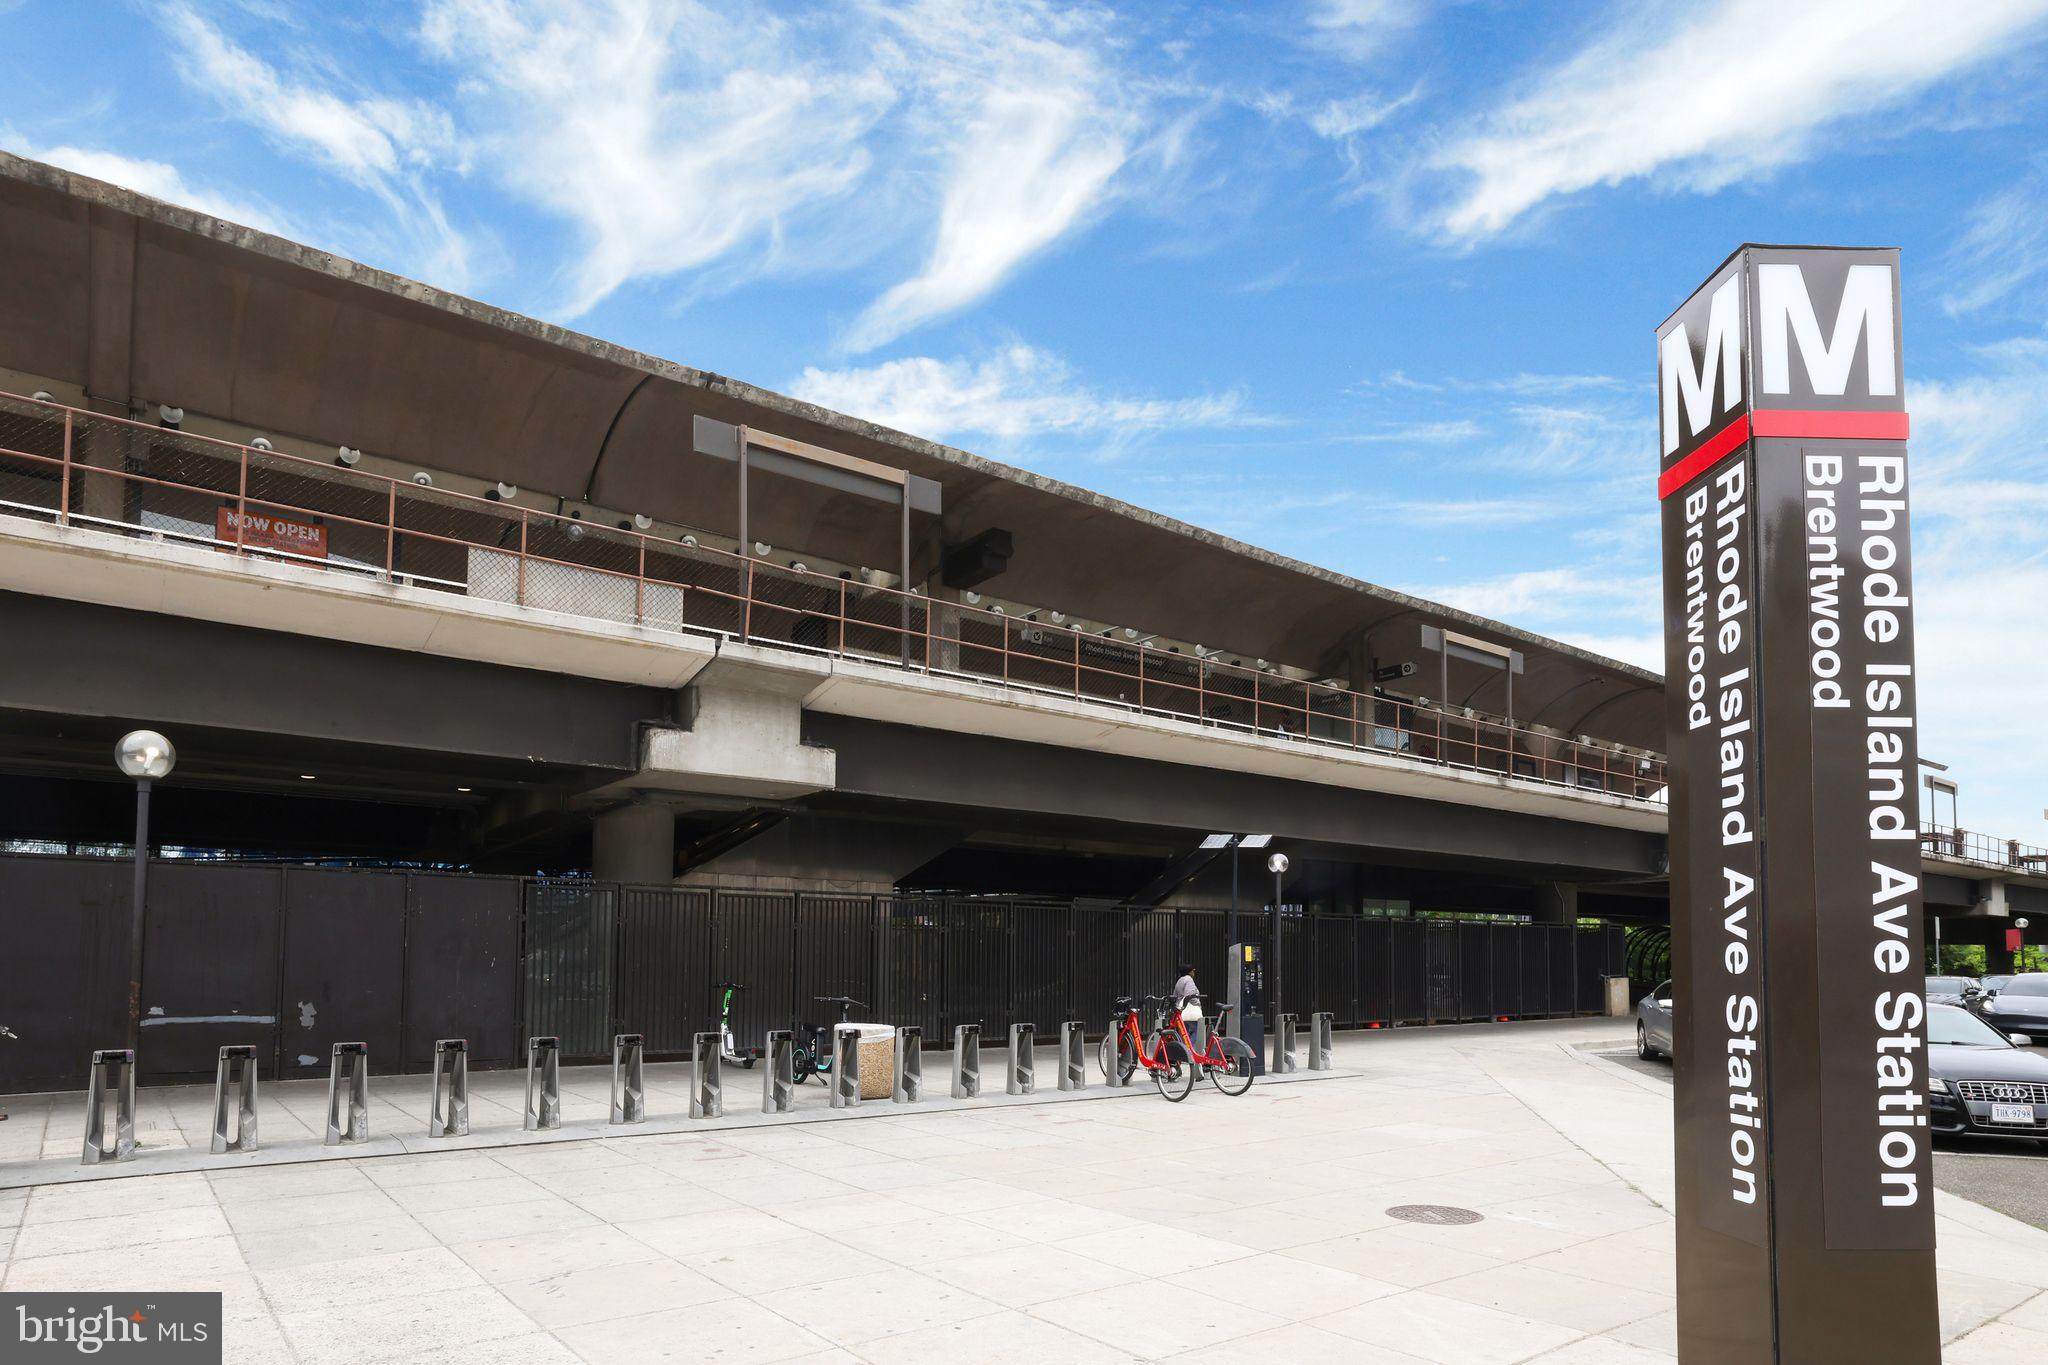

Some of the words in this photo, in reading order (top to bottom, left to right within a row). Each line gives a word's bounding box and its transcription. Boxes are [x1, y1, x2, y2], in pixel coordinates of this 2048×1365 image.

[1662, 271, 1742, 458] M
[1758, 264, 1897, 396] M
[227, 511, 270, 531] NOW
[274, 521, 320, 541] OPEN
[1685, 485, 1711, 731] Brentwood
[1716, 460, 1747, 655] Rhode
[1805, 455, 1851, 708] Brentwood
[1858, 456, 1909, 643] Rhode
[1720, 667, 1753, 846] Island
[1865, 664, 1916, 840] Island
[1723, 867, 1755, 975] Ave
[1871, 861, 1918, 974] Ave
[1726, 994, 1761, 1205] Station
[1875, 992, 1926, 1207] Station
